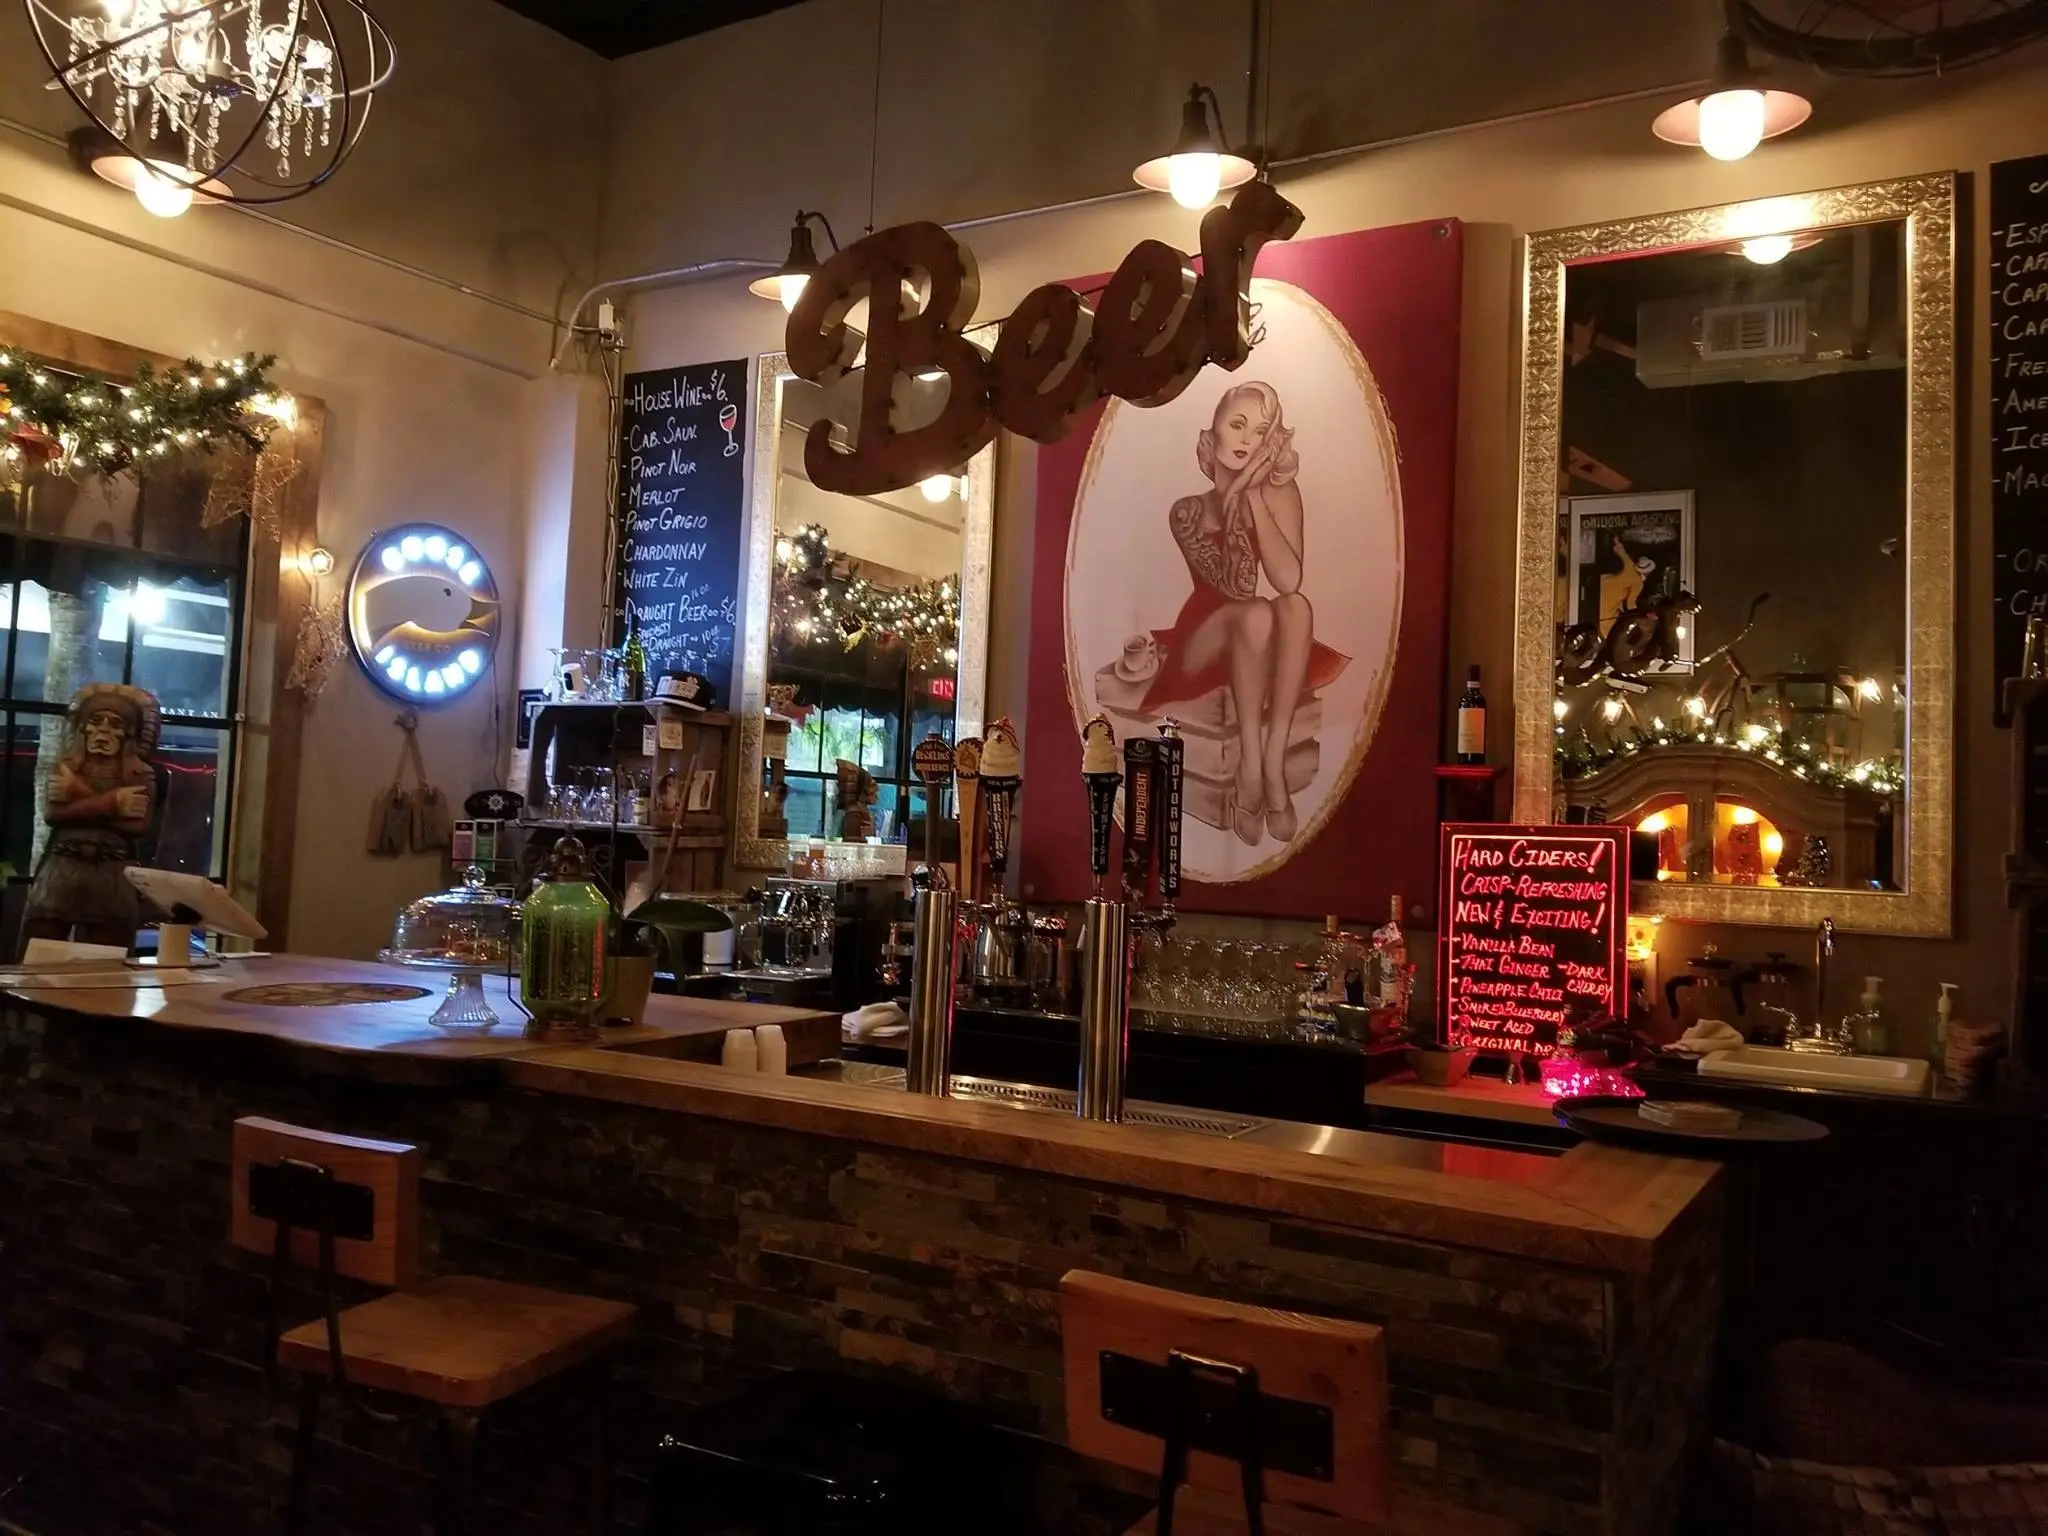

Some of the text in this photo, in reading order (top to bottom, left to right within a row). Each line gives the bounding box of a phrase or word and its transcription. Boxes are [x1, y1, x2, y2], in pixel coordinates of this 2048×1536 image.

[785, 181, 1305, 495] Beer
[634, 382, 672, 416] HOUSE
[673, 375, 703, 409] WINE
[668, 448, 697, 476] NOIR
[659, 507, 708, 530] GRIGIO
[663, 566, 689, 588] ZIN
[678, 594, 708, 623] BEER
[1455, 839, 1606, 875] HARD CIDERS!
[1455, 901, 1491, 925] NEW
[1511, 902, 1606, 935] EXCITING!
[1518, 935, 1556, 958] BEAN
[1499, 955, 1551, 979] GINGER
[1566, 979, 1613, 1004] CHERRY
[1503, 1019, 1535, 1035] AGED
